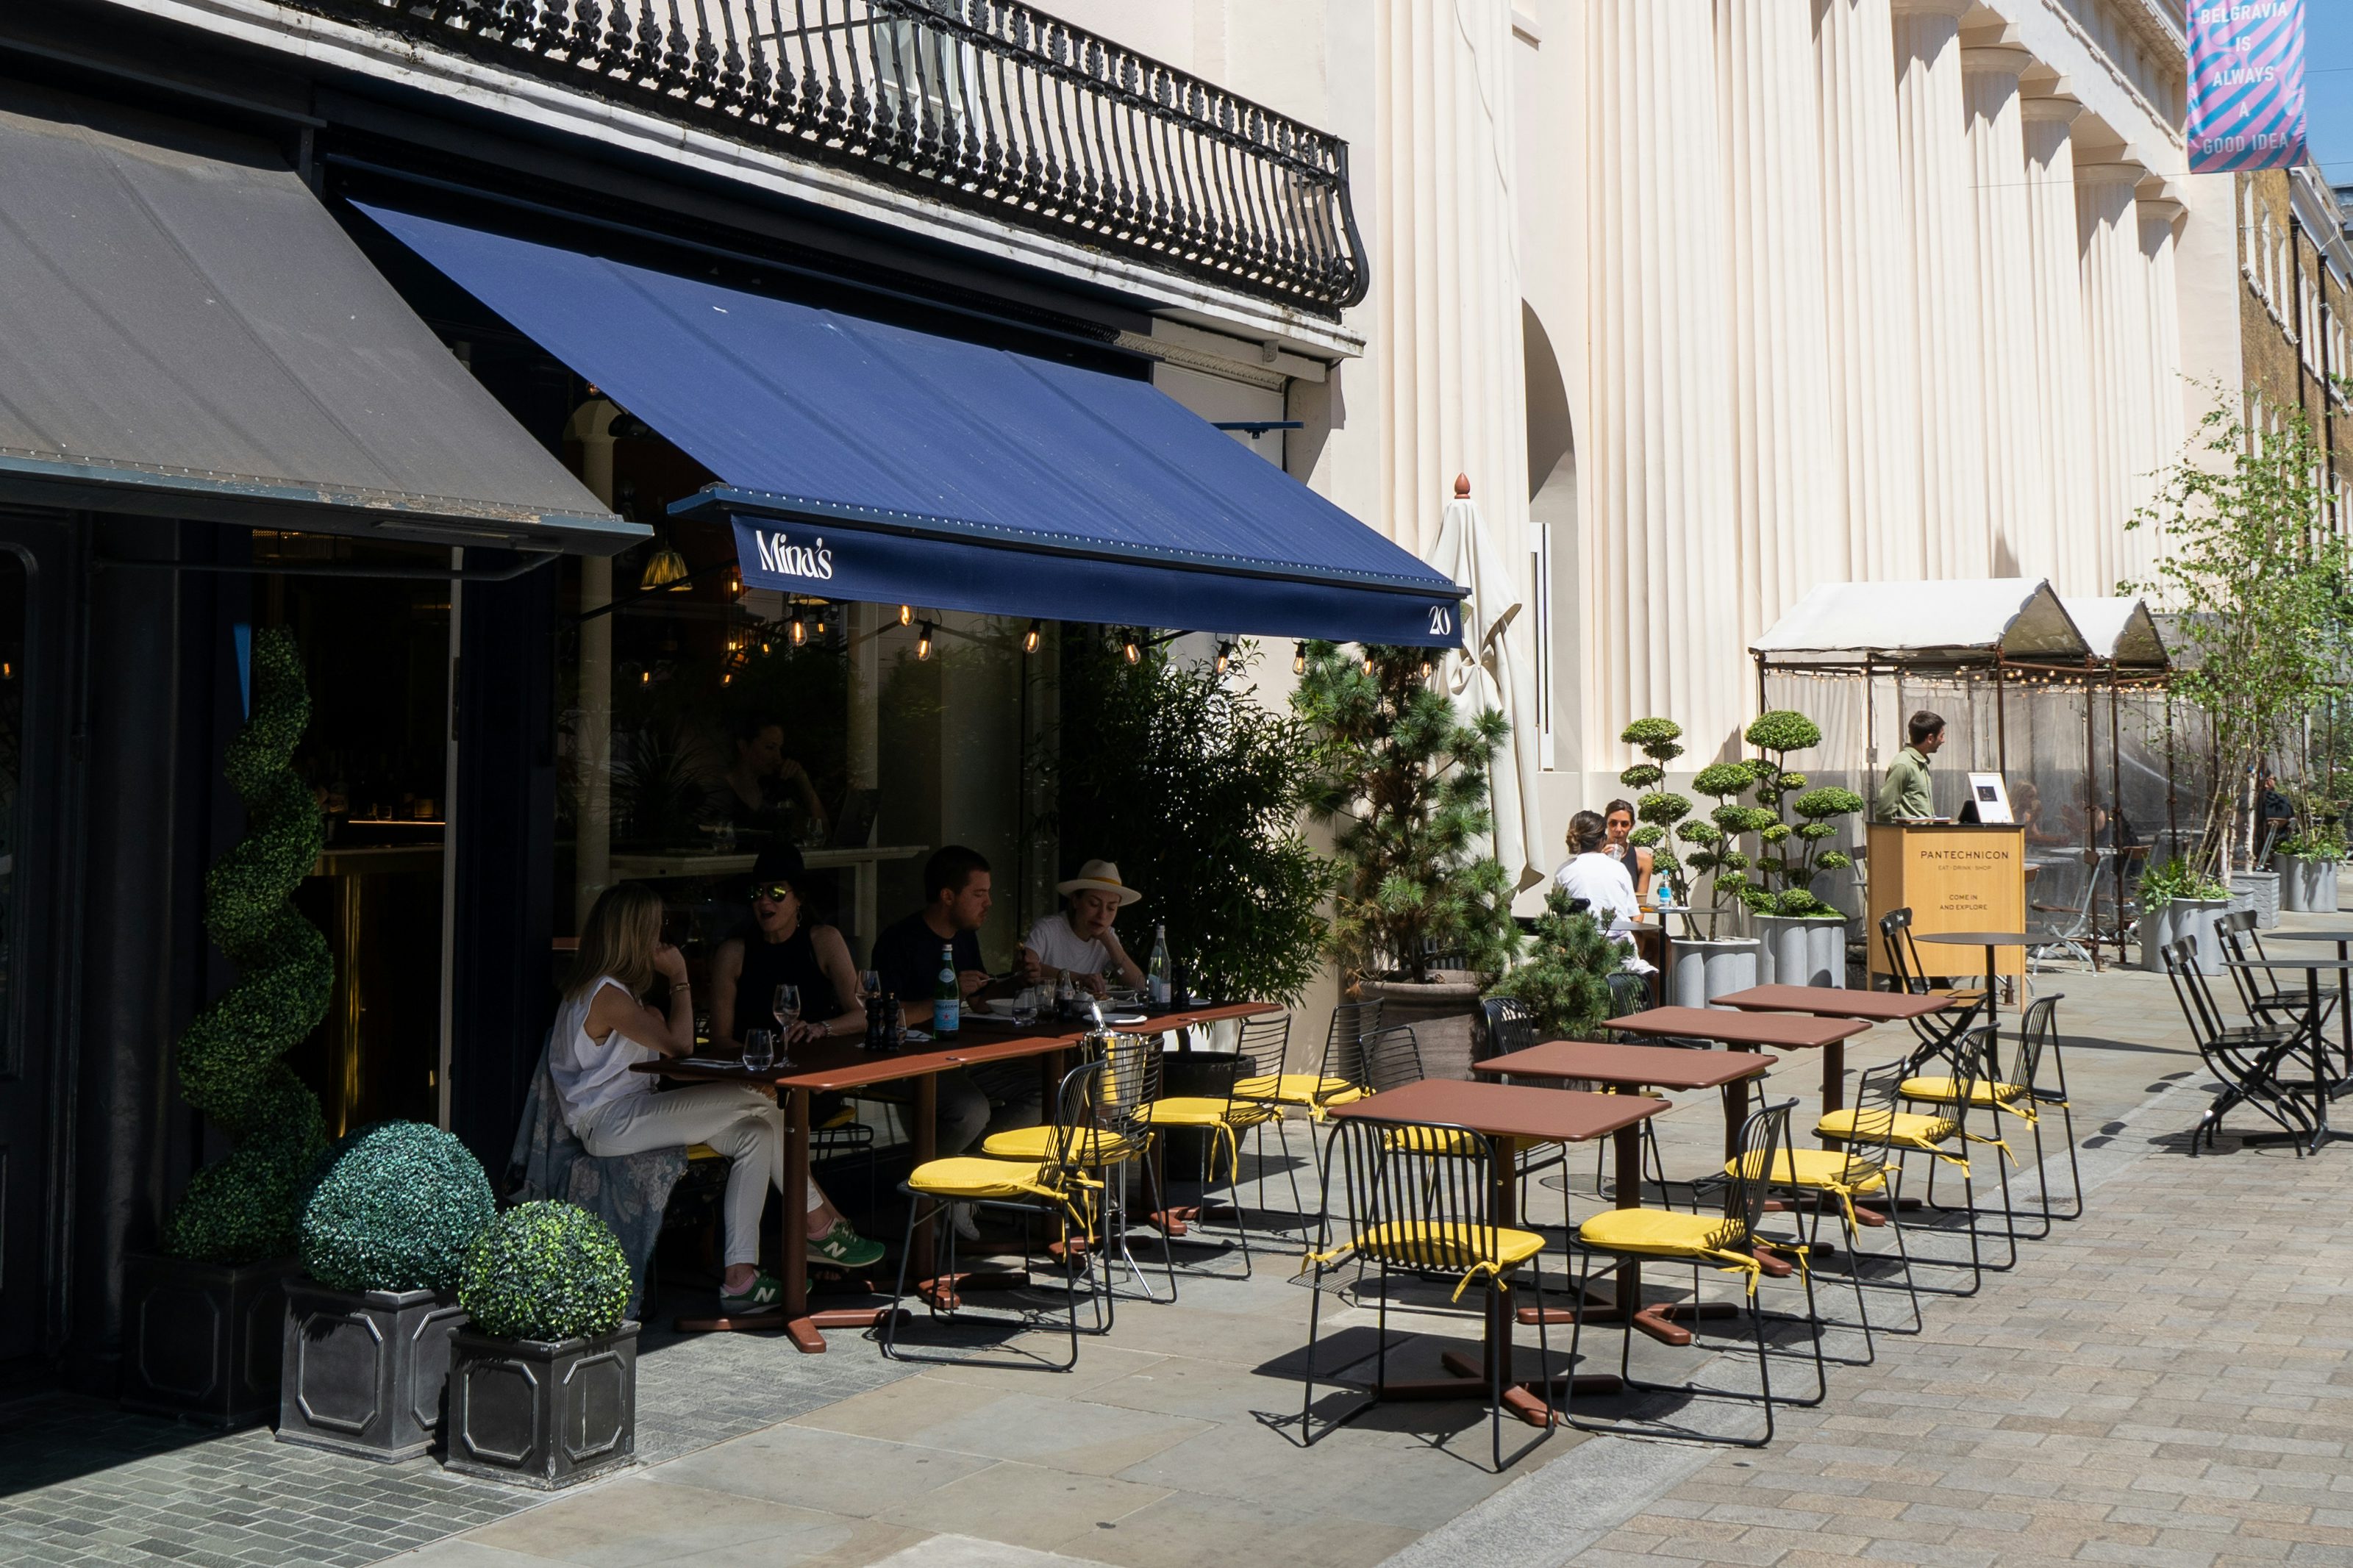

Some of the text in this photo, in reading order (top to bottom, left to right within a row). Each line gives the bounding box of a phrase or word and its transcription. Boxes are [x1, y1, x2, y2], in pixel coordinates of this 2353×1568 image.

[2200, 2, 2288, 24] BELGRAVIA
[2235, 36, 2252, 52] IS
[2213, 65, 2274, 87] ALWAYS
[2238, 101, 2249, 118] A
[2202, 132, 2288, 154] GOOD IDEA
[756, 530, 832, 580] Mina's
[1428, 605, 1451, 636] 20
[1921, 851, 2009, 859] PANTECHNICON
[824, 1241, 847, 1258] N
[754, 1286, 776, 1303] N
